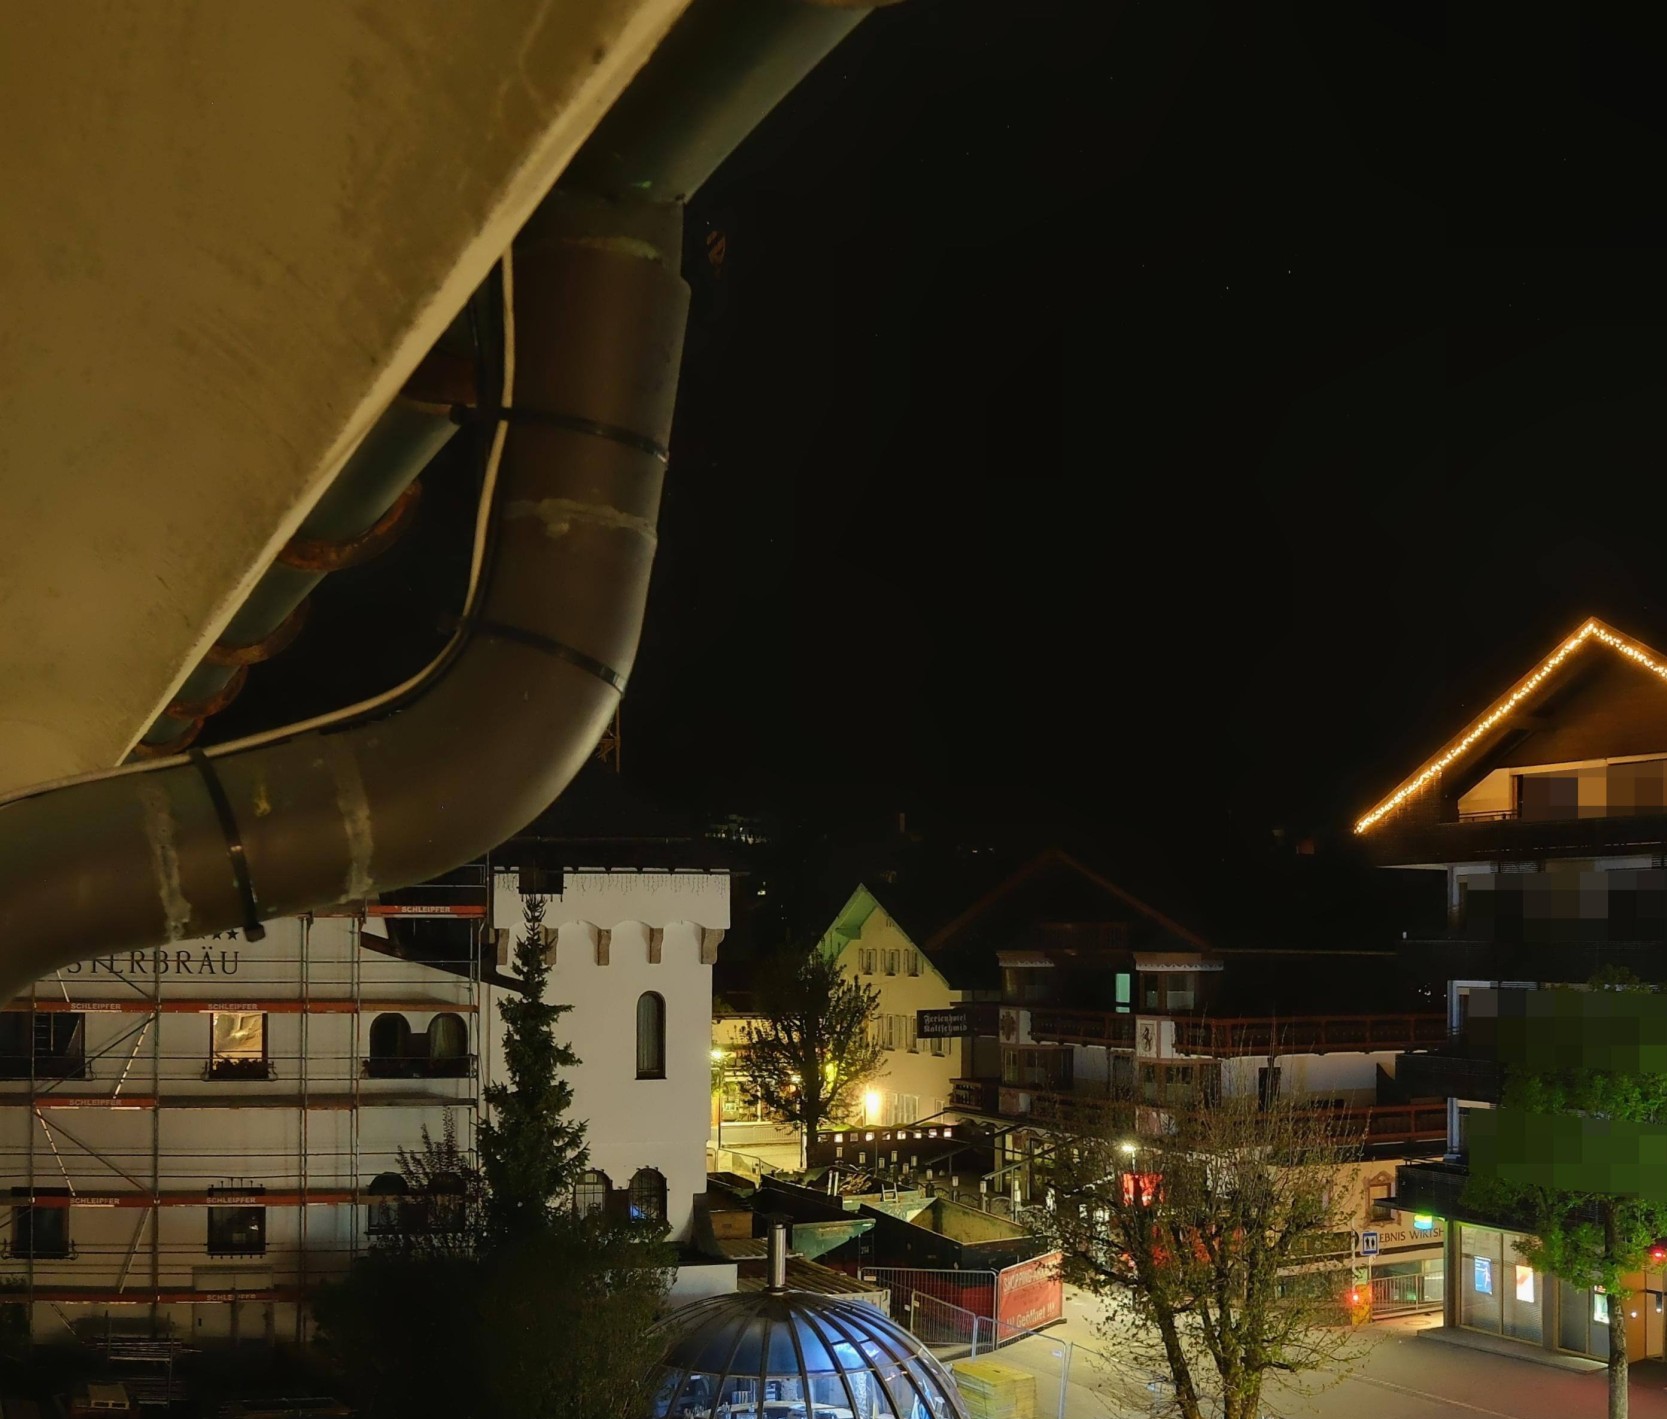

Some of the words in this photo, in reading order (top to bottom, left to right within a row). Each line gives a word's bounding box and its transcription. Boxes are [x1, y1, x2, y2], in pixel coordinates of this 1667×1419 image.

[401, 905, 450, 913] SCHLEIPFER
[71, 1002, 121, 1010] SCHLEIPFER
[1379, 1231, 1406, 1243] EBNIS
